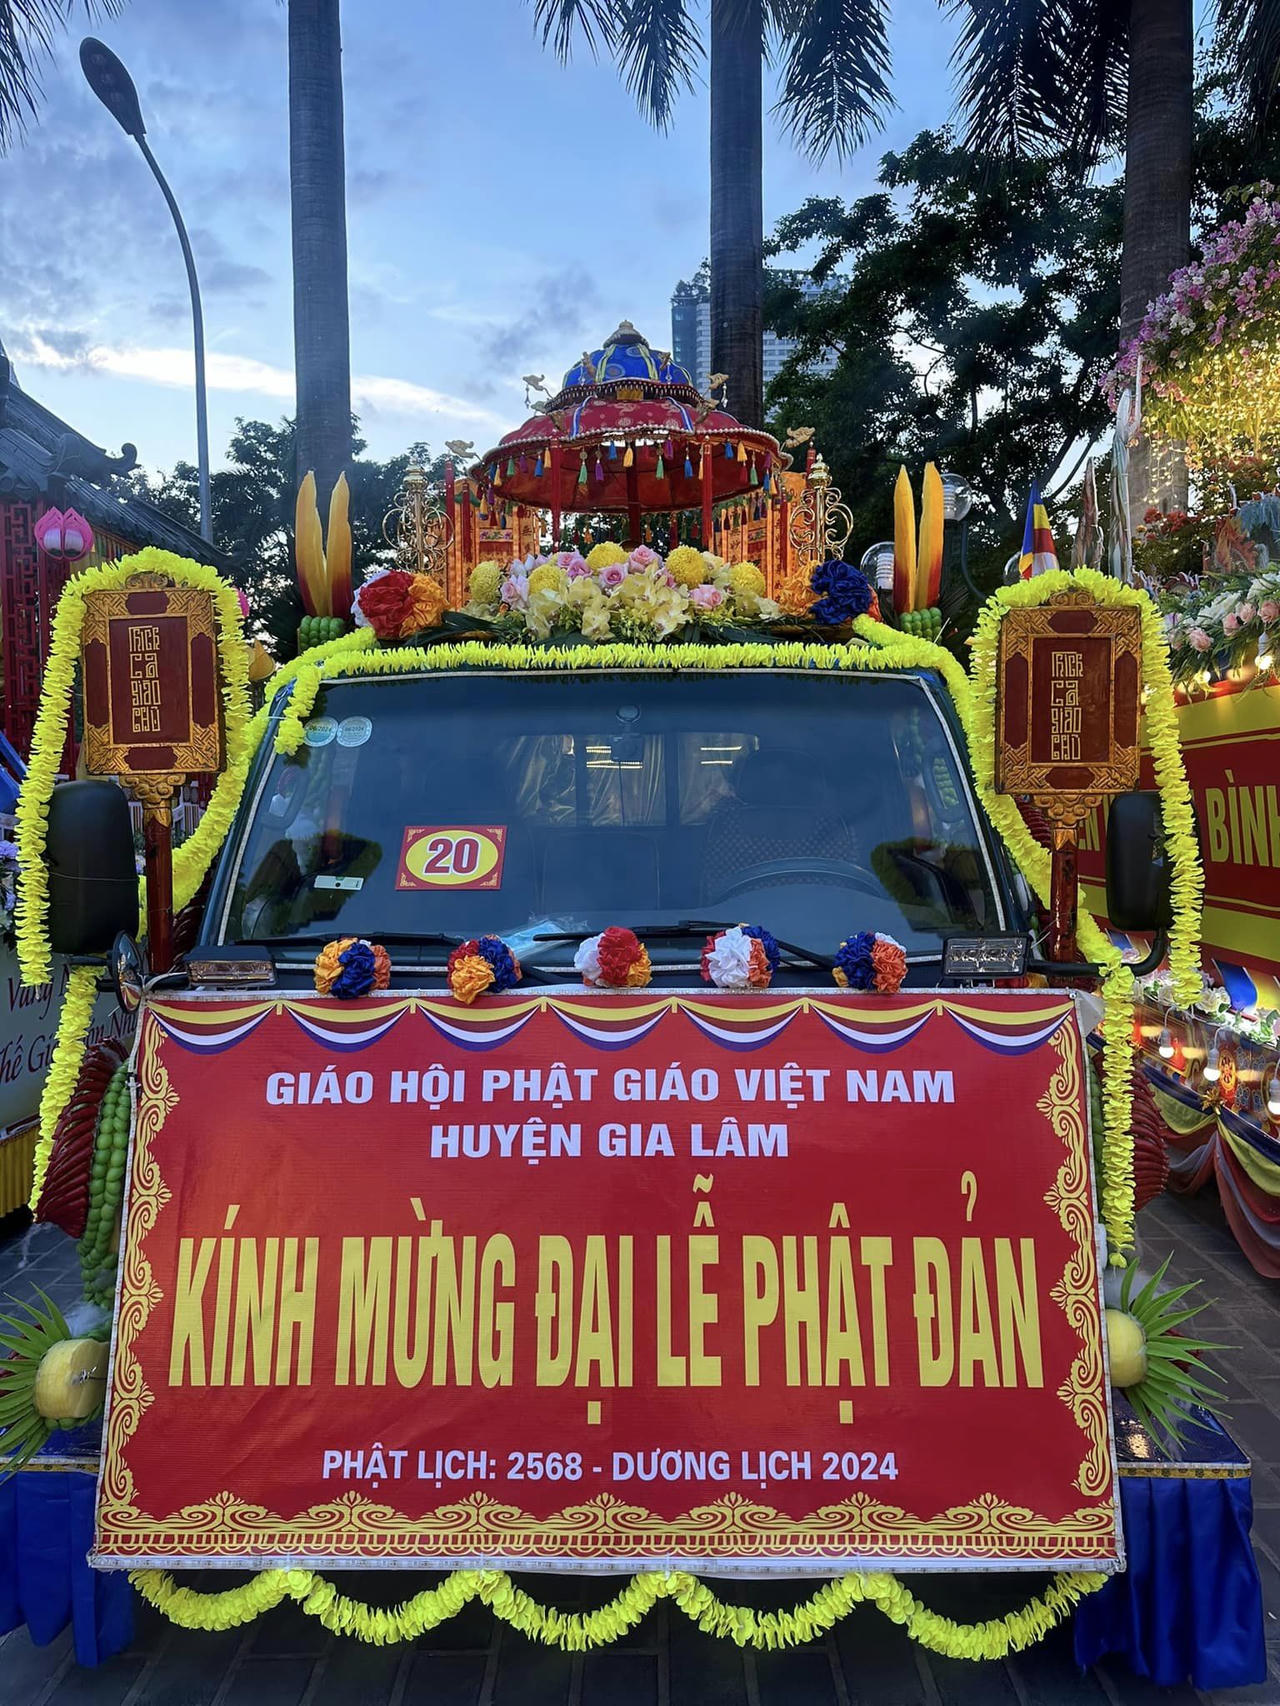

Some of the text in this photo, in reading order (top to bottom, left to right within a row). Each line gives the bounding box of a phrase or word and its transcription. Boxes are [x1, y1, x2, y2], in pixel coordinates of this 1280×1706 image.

[423, 837, 480, 876] 20
[267, 1062, 955, 1109] GIÁO HỘI PHẬT GIÁO VIỆT NAM
[431, 1117, 788, 1165] HUYỆN GIA LÂM
[168, 1171, 1044, 1425] KÍNH MỪNG ĐẠI LỄ PHẬT ĐẢN
[323, 1443, 407, 1488] PHẬT
[418, 1451, 495, 1489] LỊCH:
[508, 1452, 583, 1480] 2568
[613, 1448, 729, 1480] DƯƠNG
[742, 1451, 812, 1489] LỊCH
[823, 1452, 899, 1481] 2024
